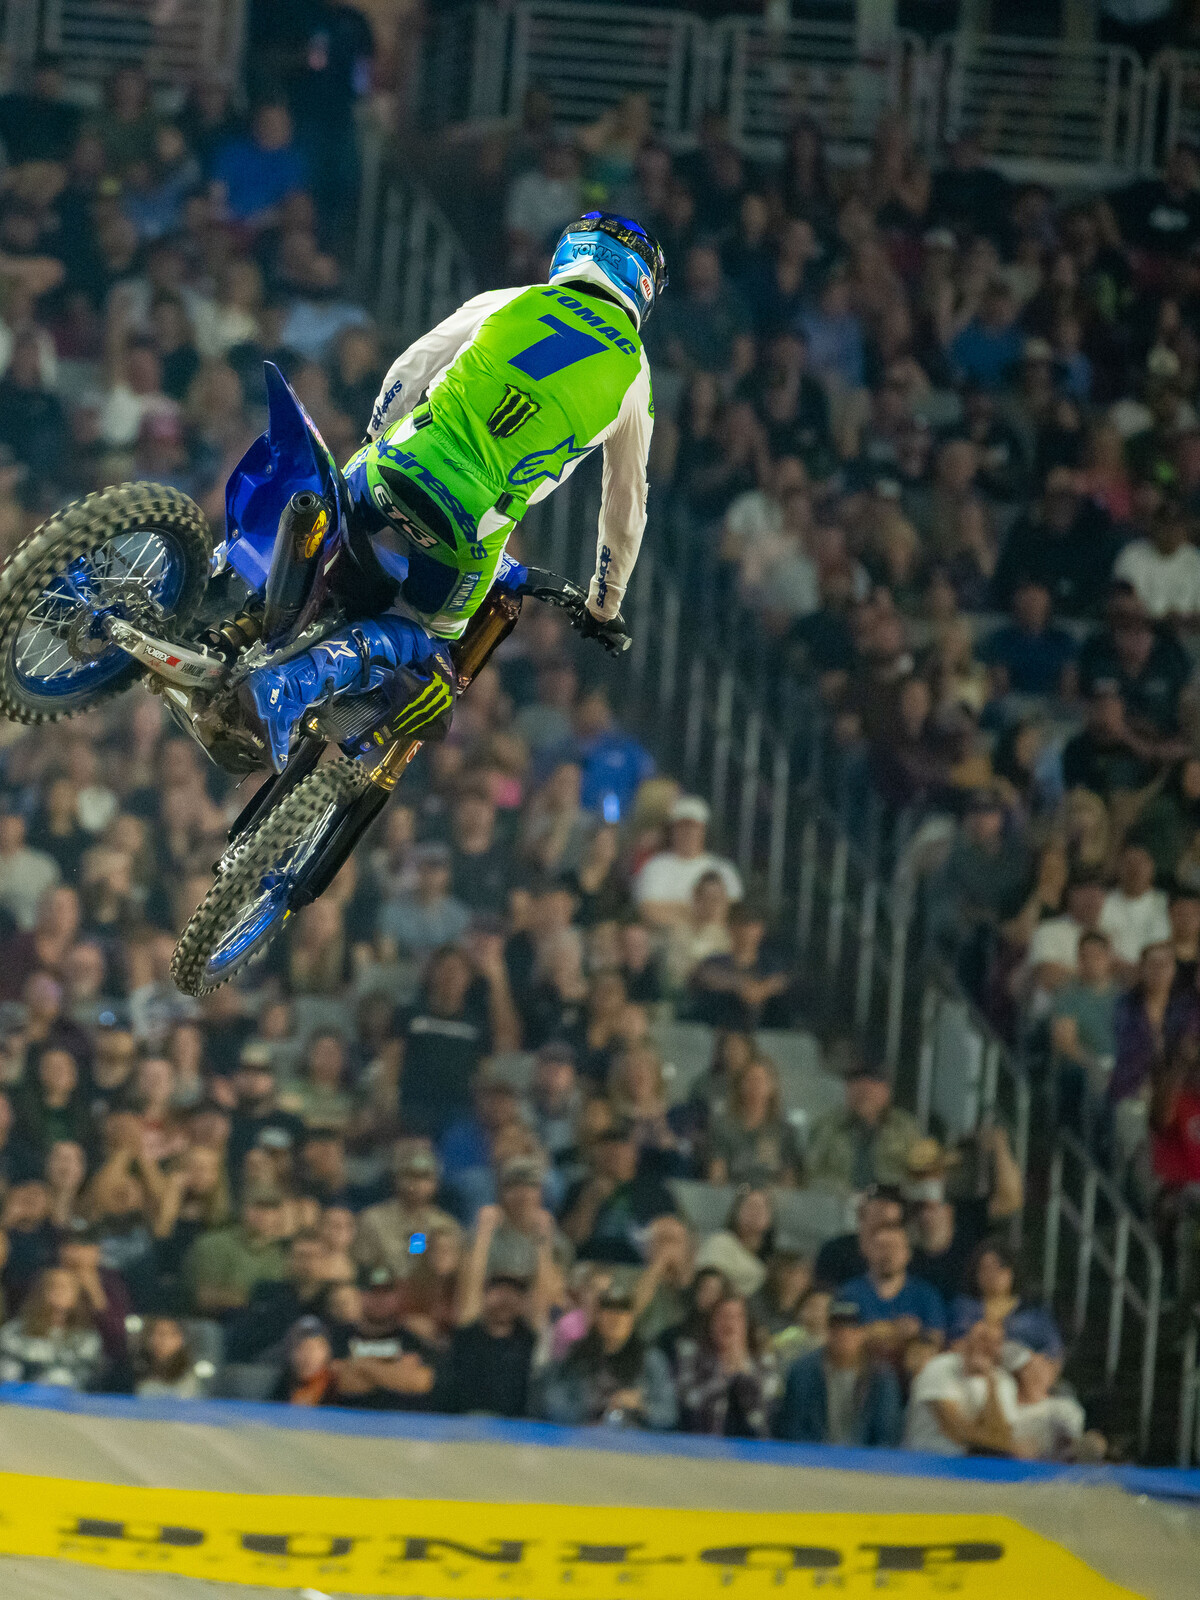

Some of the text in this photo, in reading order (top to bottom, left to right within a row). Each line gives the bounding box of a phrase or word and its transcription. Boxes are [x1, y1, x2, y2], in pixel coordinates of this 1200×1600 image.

[572, 243, 621, 270] TOMAC
[642, 278, 652, 298] BELL
[540, 287, 637, 356] TOMAC
[143, 643, 171, 663] VORTEX
[58, 1516, 1006, 1572] DUNLOP
